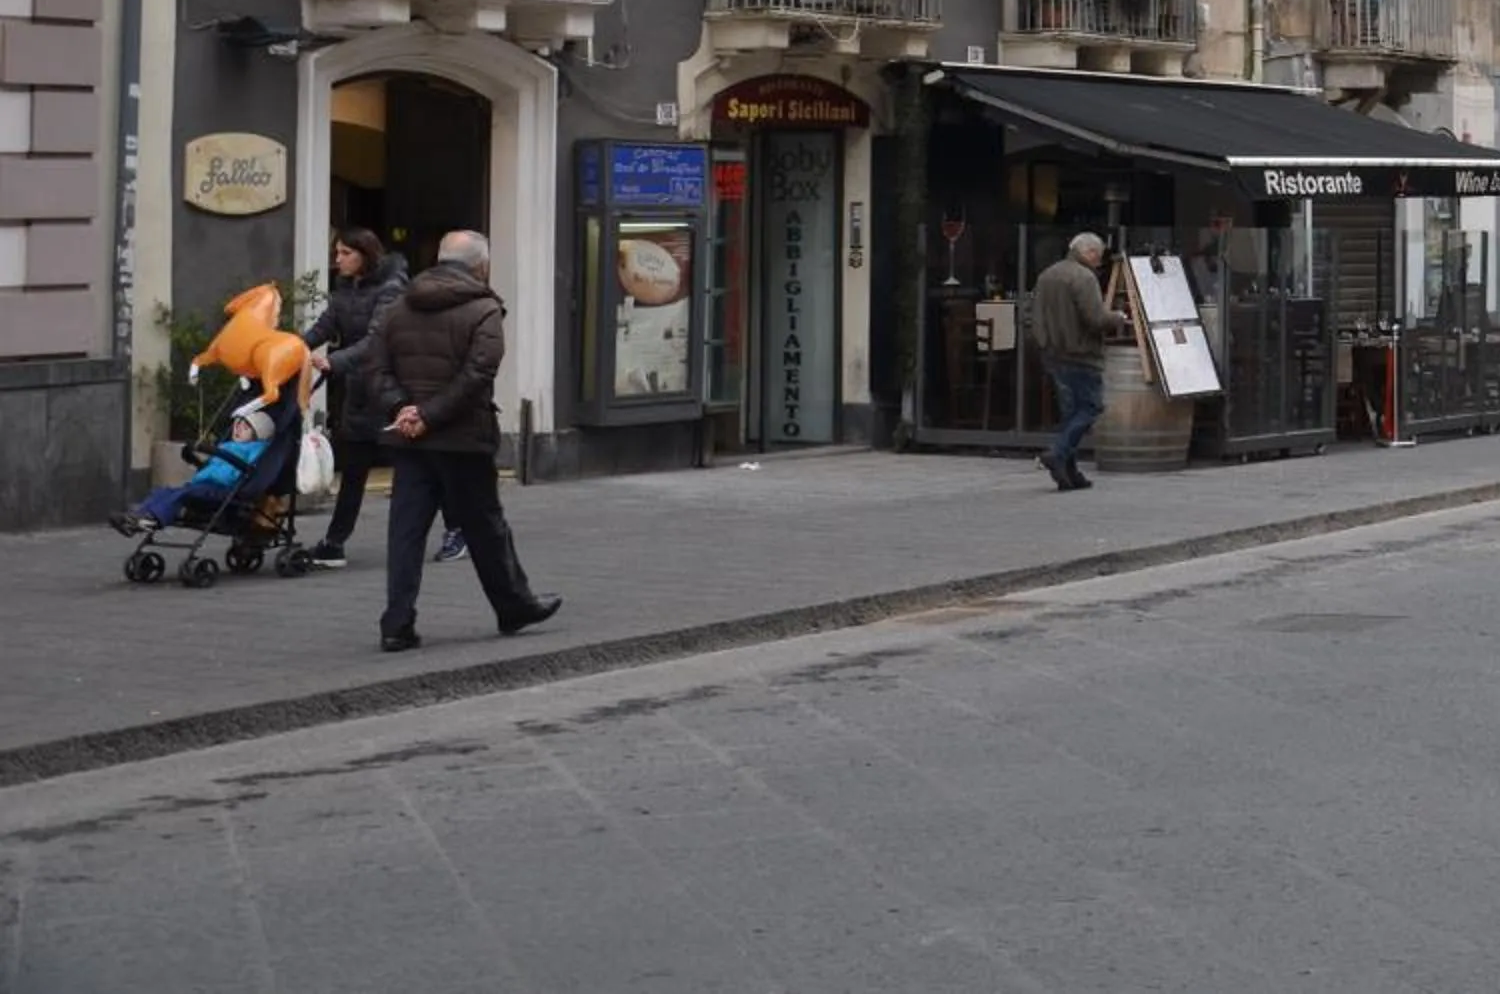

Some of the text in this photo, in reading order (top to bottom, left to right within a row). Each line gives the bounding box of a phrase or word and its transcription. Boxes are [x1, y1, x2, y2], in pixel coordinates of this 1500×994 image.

[727, 97, 856, 123] Sapori Siciliani
[1263, 169, 1363, 196] Ristorante
[1455, 170, 1489, 193] Wine
[783, 209, 802, 438] ABBIGLIAMENTO
